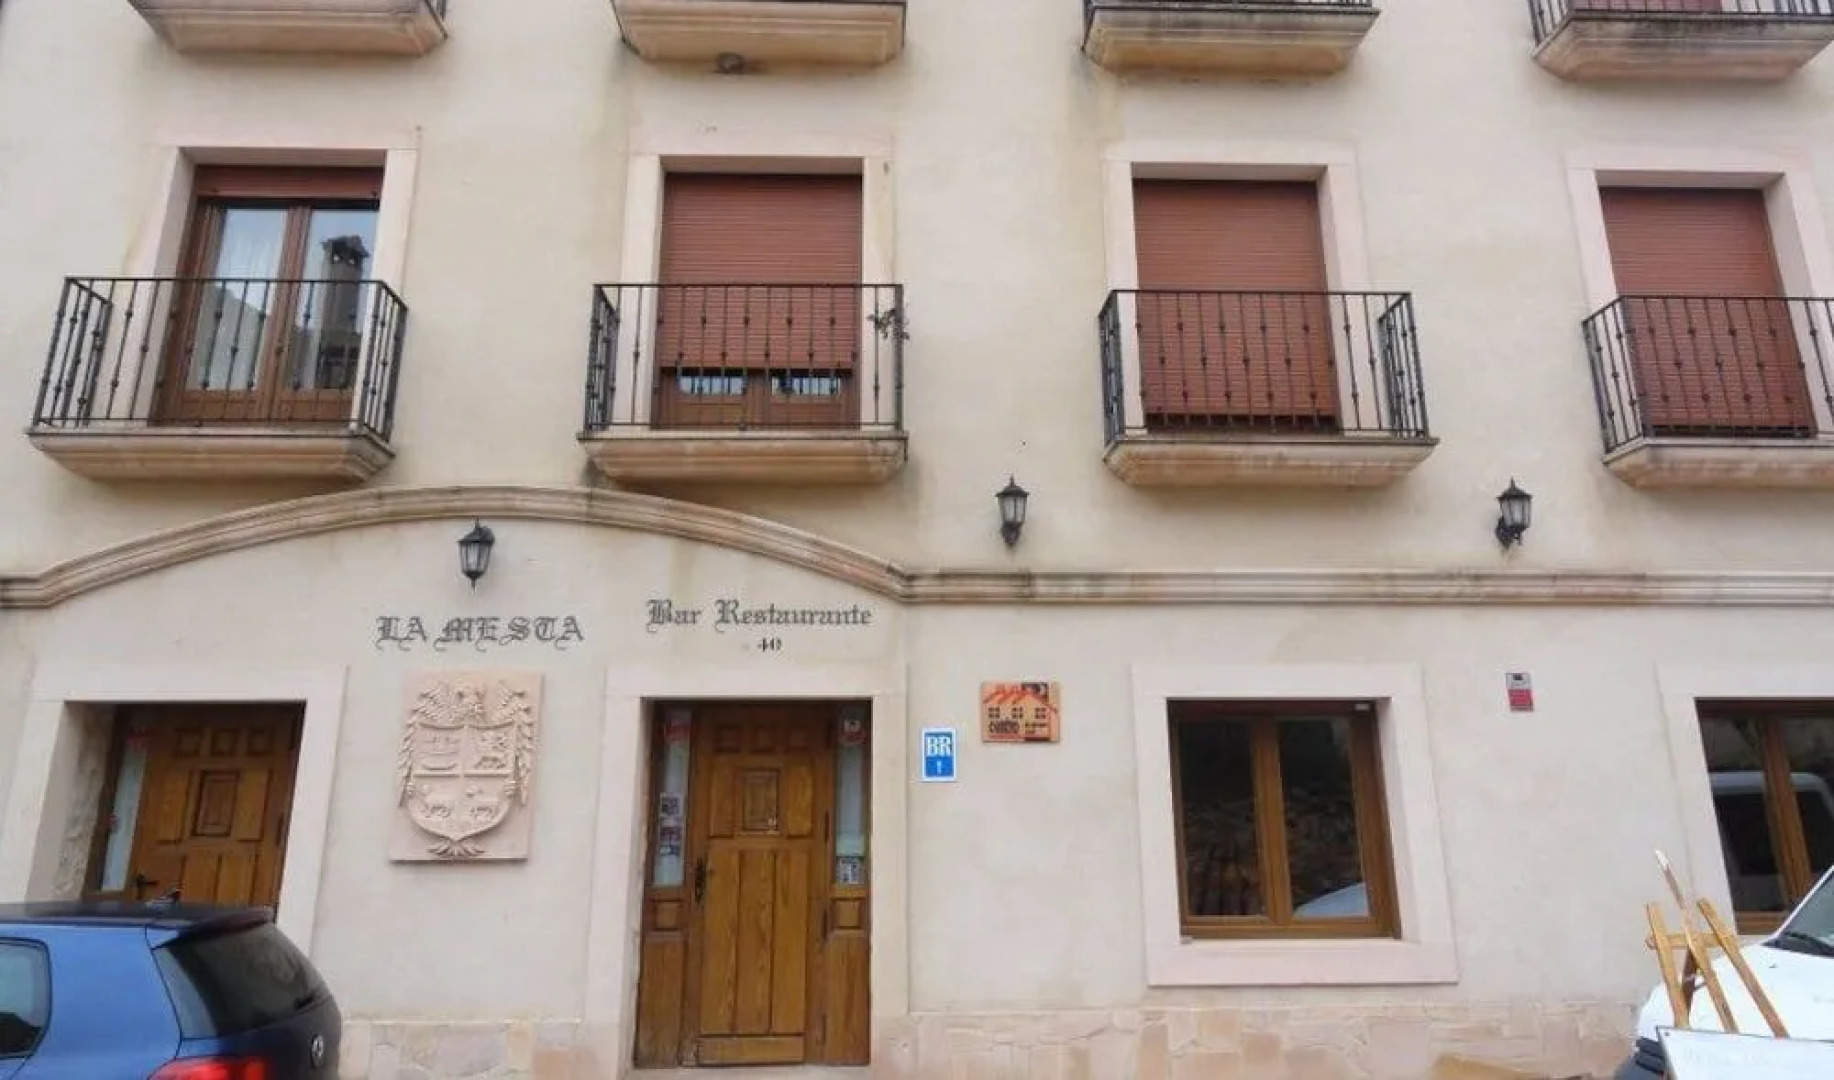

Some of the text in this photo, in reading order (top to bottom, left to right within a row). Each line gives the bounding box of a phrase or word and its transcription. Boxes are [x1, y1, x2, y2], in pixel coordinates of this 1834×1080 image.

[376, 615, 584, 651] LA MESTA
[646, 599, 872, 633] Bar Restaurante
[926, 736, 952, 757] BR
